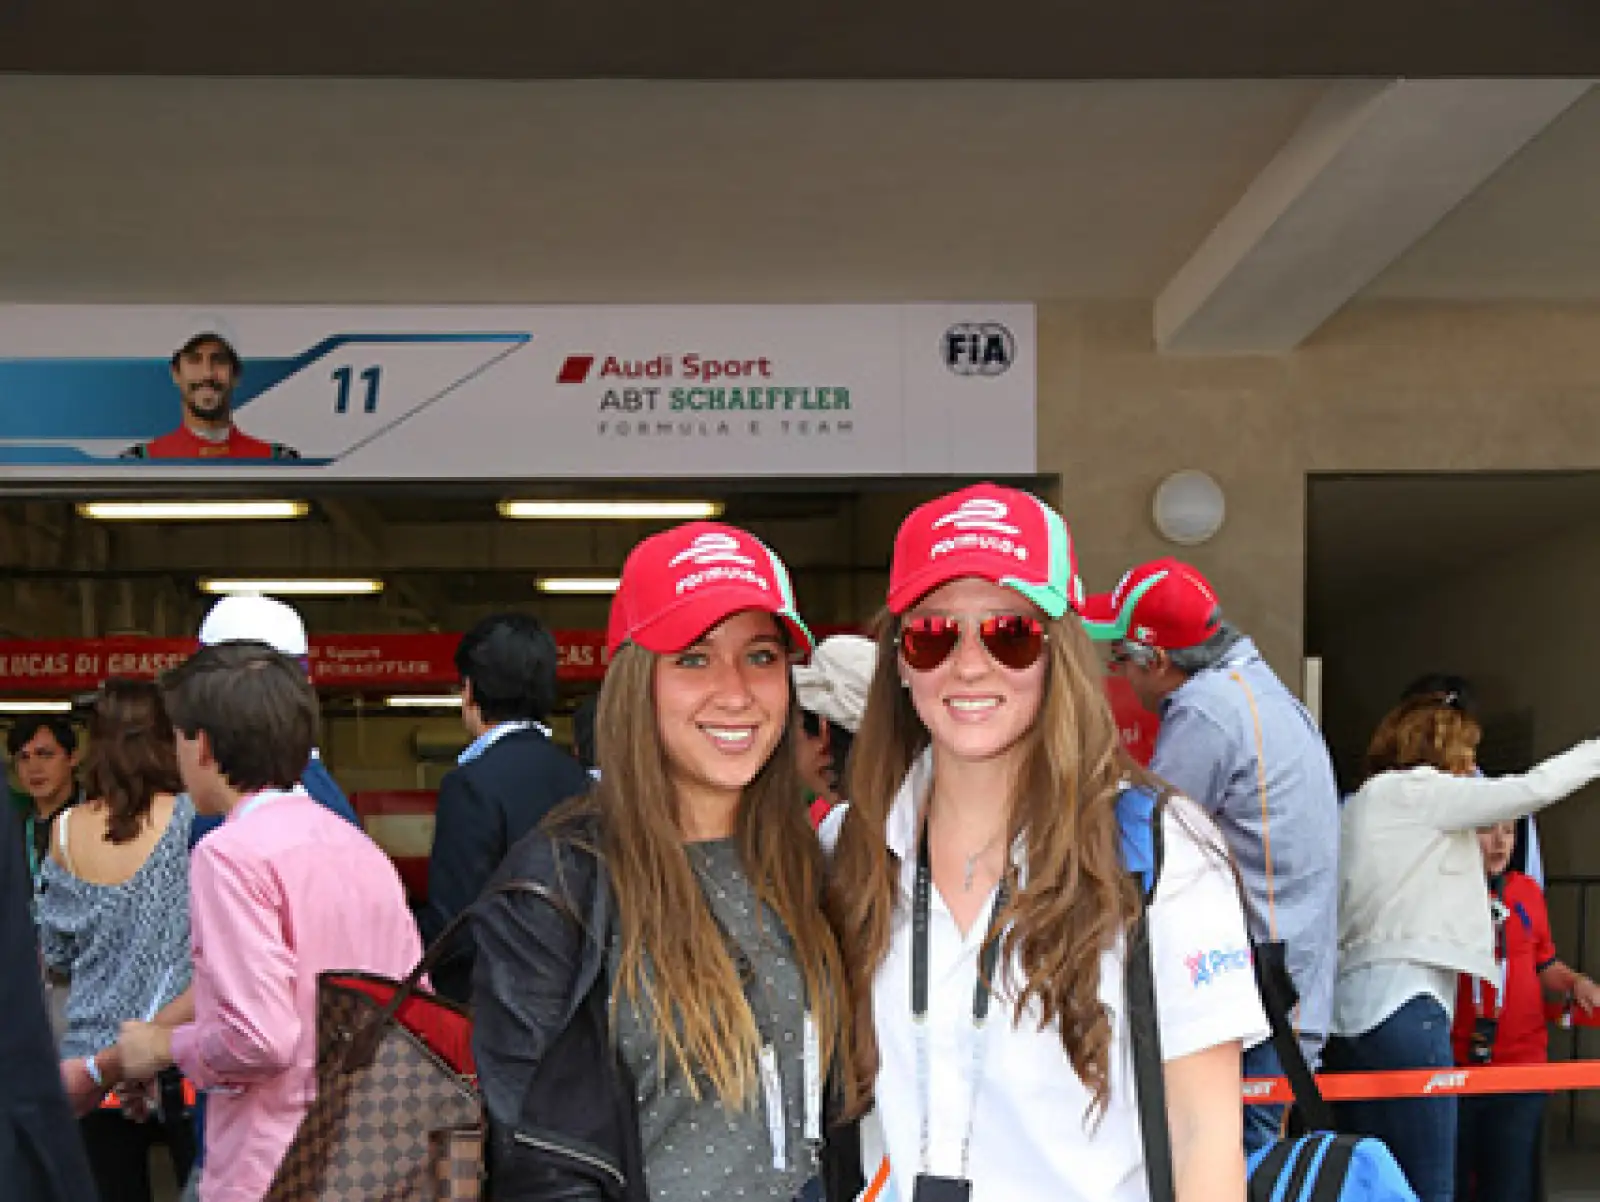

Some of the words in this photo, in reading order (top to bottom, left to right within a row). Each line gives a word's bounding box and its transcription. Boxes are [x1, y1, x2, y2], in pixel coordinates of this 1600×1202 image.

[947, 333, 1010, 364] FIA
[599, 354, 673, 379] Audi
[682, 353, 771, 384] Sport
[333, 366, 383, 413] 11
[599, 387, 662, 412] ABT
[668, 387, 850, 411] SCHAEFFLER
[598, 421, 729, 436] FORMULA
[748, 421, 759, 436] E
[781, 421, 853, 436] TEAM
